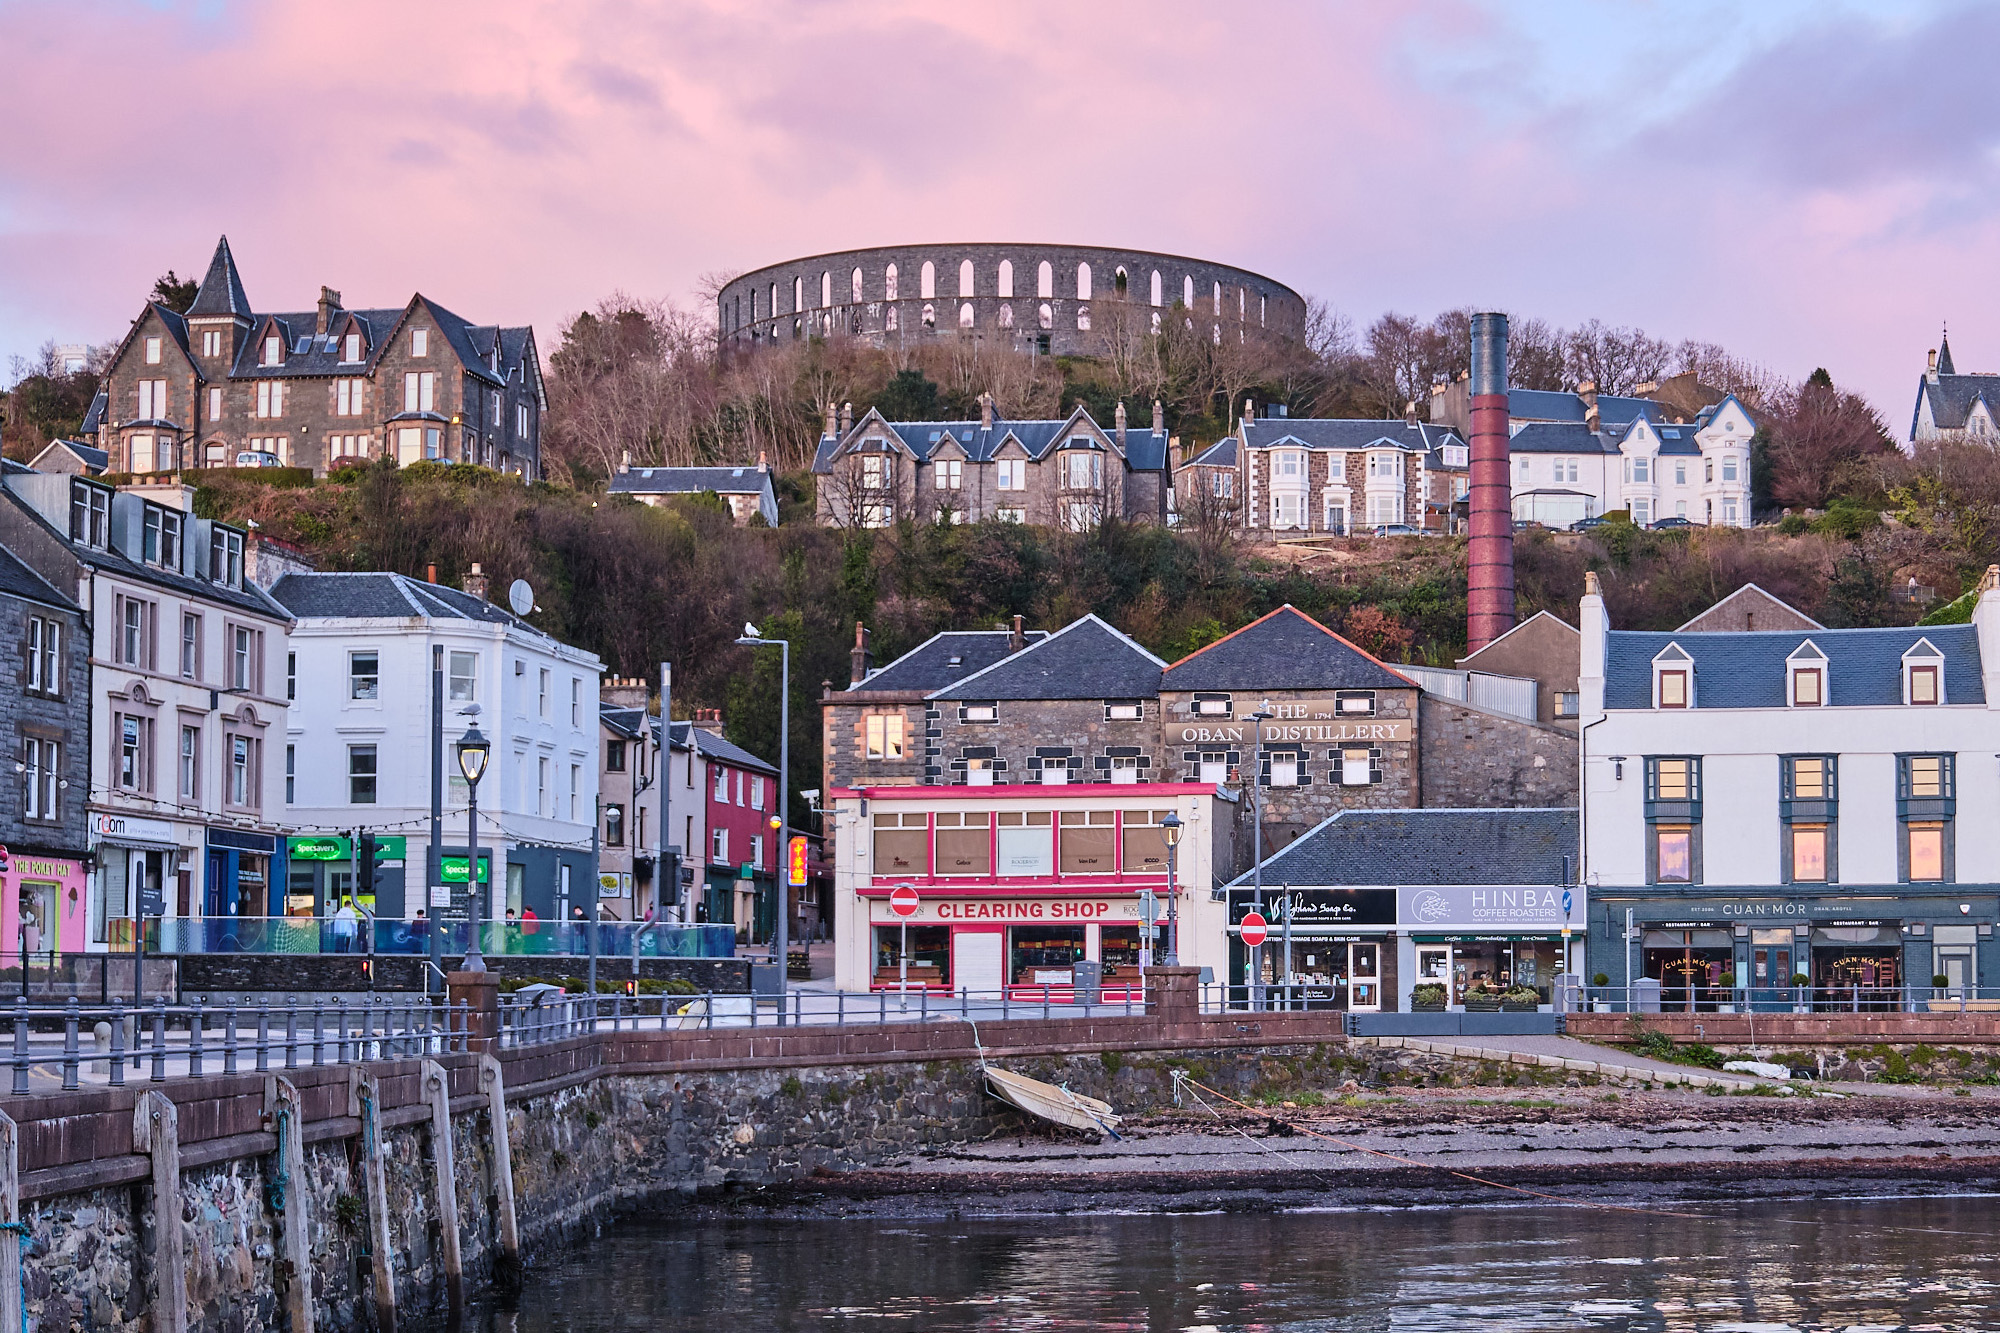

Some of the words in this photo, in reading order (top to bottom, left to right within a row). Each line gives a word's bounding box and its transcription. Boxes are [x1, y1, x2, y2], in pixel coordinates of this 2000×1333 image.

[1266, 704, 1308, 719] THE
[1314, 712, 1332, 720] 1794
[1181, 727, 1244, 742] OBAN
[1265, 724, 1400, 741] DISTILLERY
[297, 843, 335, 853] Specsavers
[15, 860, 29, 873] THE
[31, 861, 55, 875] POKEY
[57, 864, 71, 877] HAT
[1472, 890, 1557, 907] HINBA
[938, 903, 1043, 919] CLEARING
[1051, 902, 1109, 918] SHOP
[1319, 903, 1341, 916] Soap
[1472, 908, 1507, 917] COFFEE
[1509, 908, 1557, 917] ROASTERS
